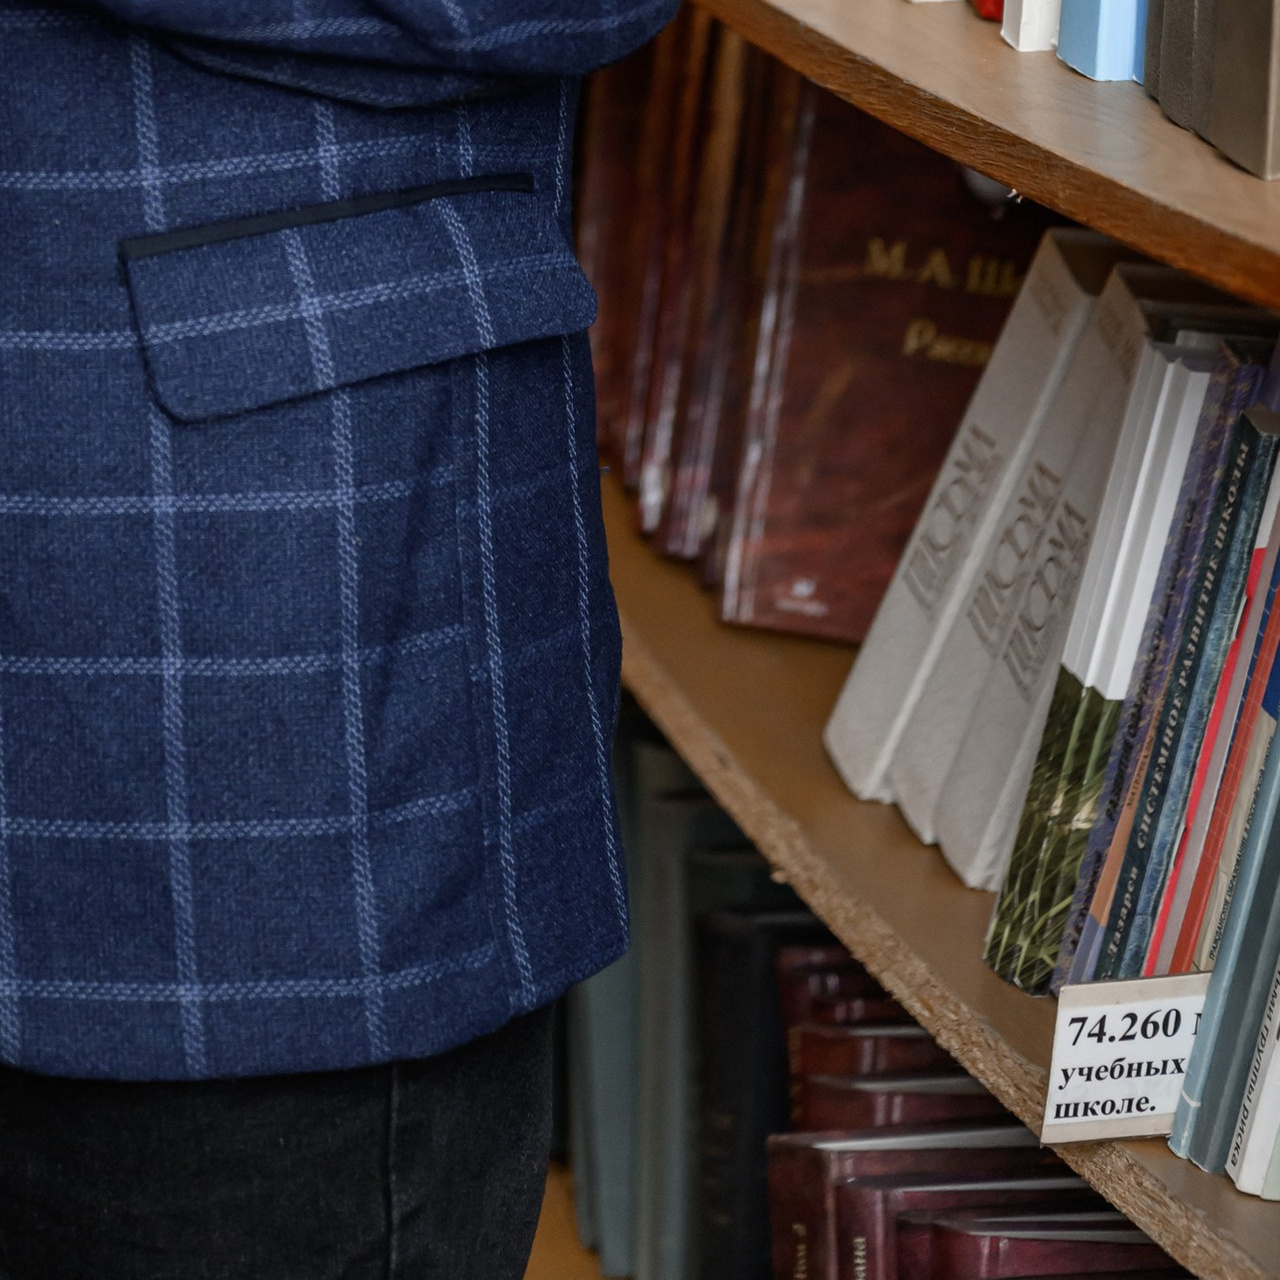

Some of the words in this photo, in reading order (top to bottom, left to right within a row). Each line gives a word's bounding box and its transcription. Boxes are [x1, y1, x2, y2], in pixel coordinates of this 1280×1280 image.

[1107, 866, 1139, 962] Лазарев
[1137, 692, 1183, 850] СИСТЕМНОЕ
[1178, 554, 1219, 687] РАЗВИТИЕ
[1214, 442, 1250, 549] ШКОЛЫ
[1209, 898, 1231, 960] ГРАЖДАНСКОЕ
[1227, 835, 1247, 898] ОБРАЗОВАНИЕ
[1068, 1007, 1182, 1046] 74.260
[1058, 1056, 1187, 1091] учебных
[1246, 1024, 1269, 1104] группы
[1053, 1094, 1156, 1120] школе.
[1231, 1105, 1250, 1167] риска
